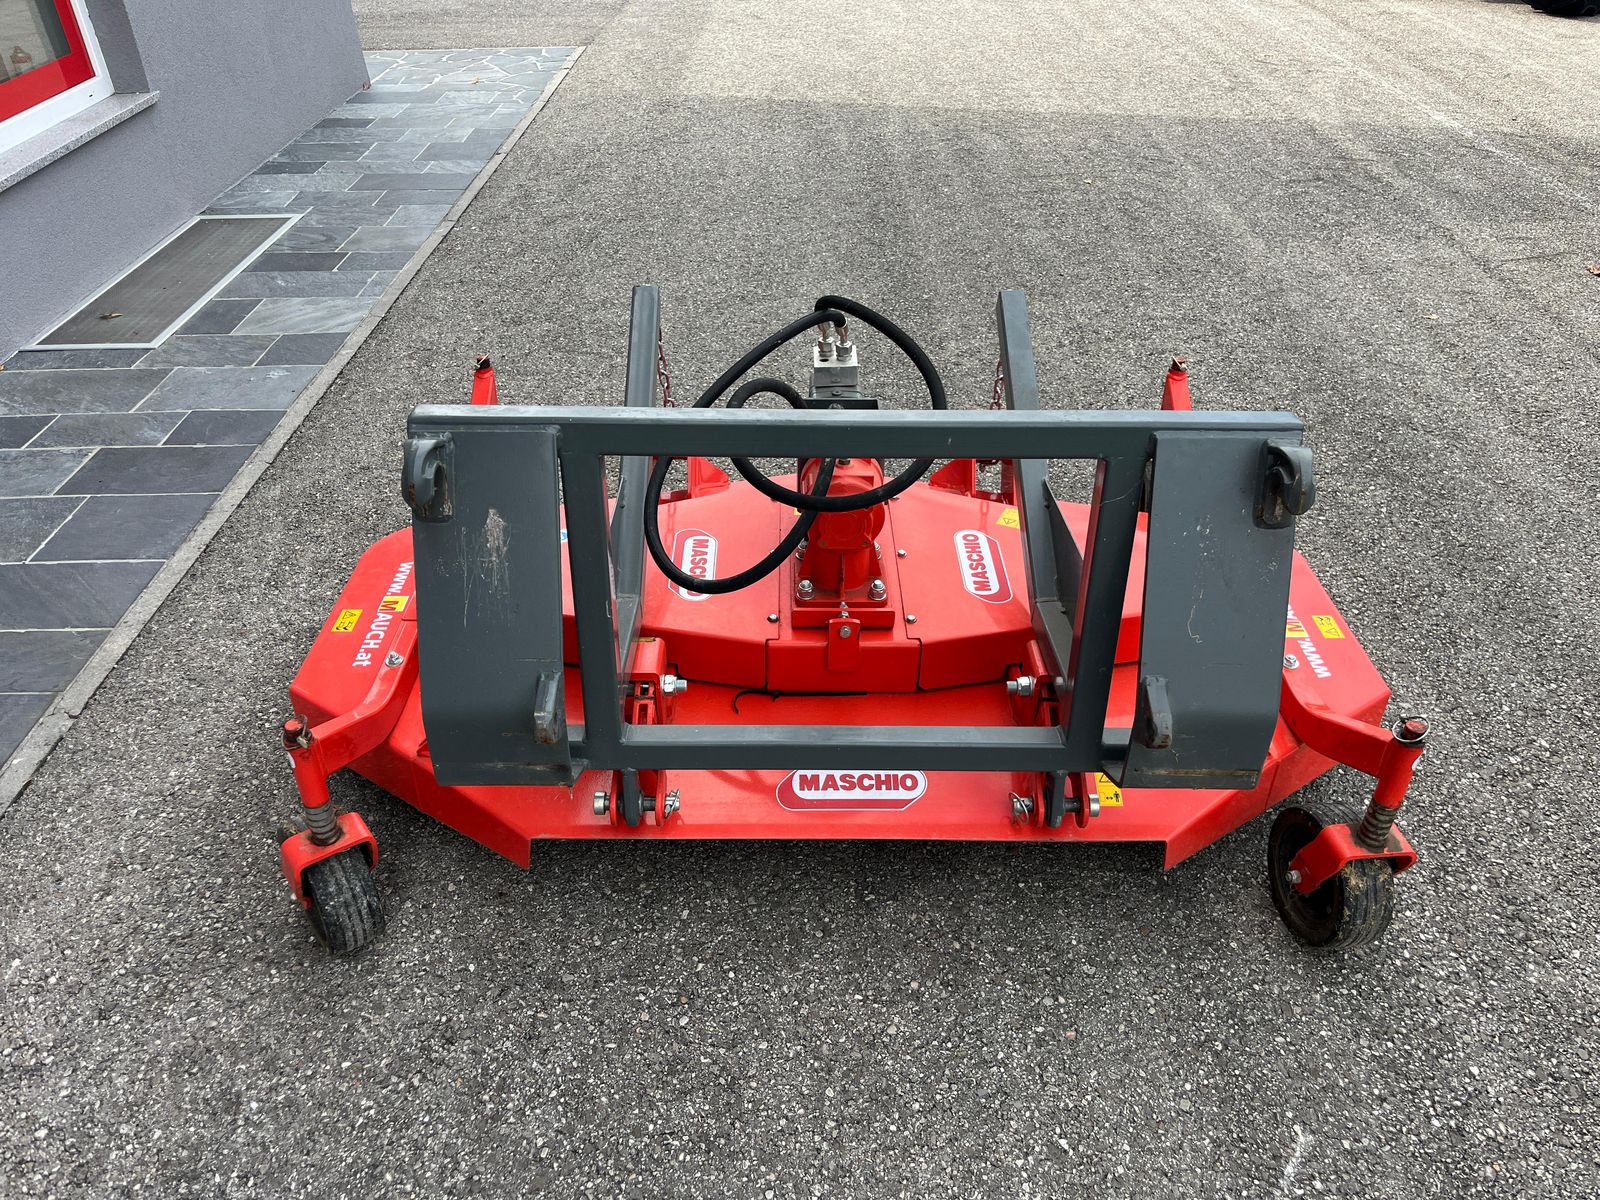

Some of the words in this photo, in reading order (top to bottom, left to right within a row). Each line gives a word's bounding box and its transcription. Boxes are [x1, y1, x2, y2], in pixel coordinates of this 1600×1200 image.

[962, 533, 992, 592] MASCHIO
[352, 561, 414, 667] www.MAUCH.at
[798, 773, 919, 792] MASCHIO
